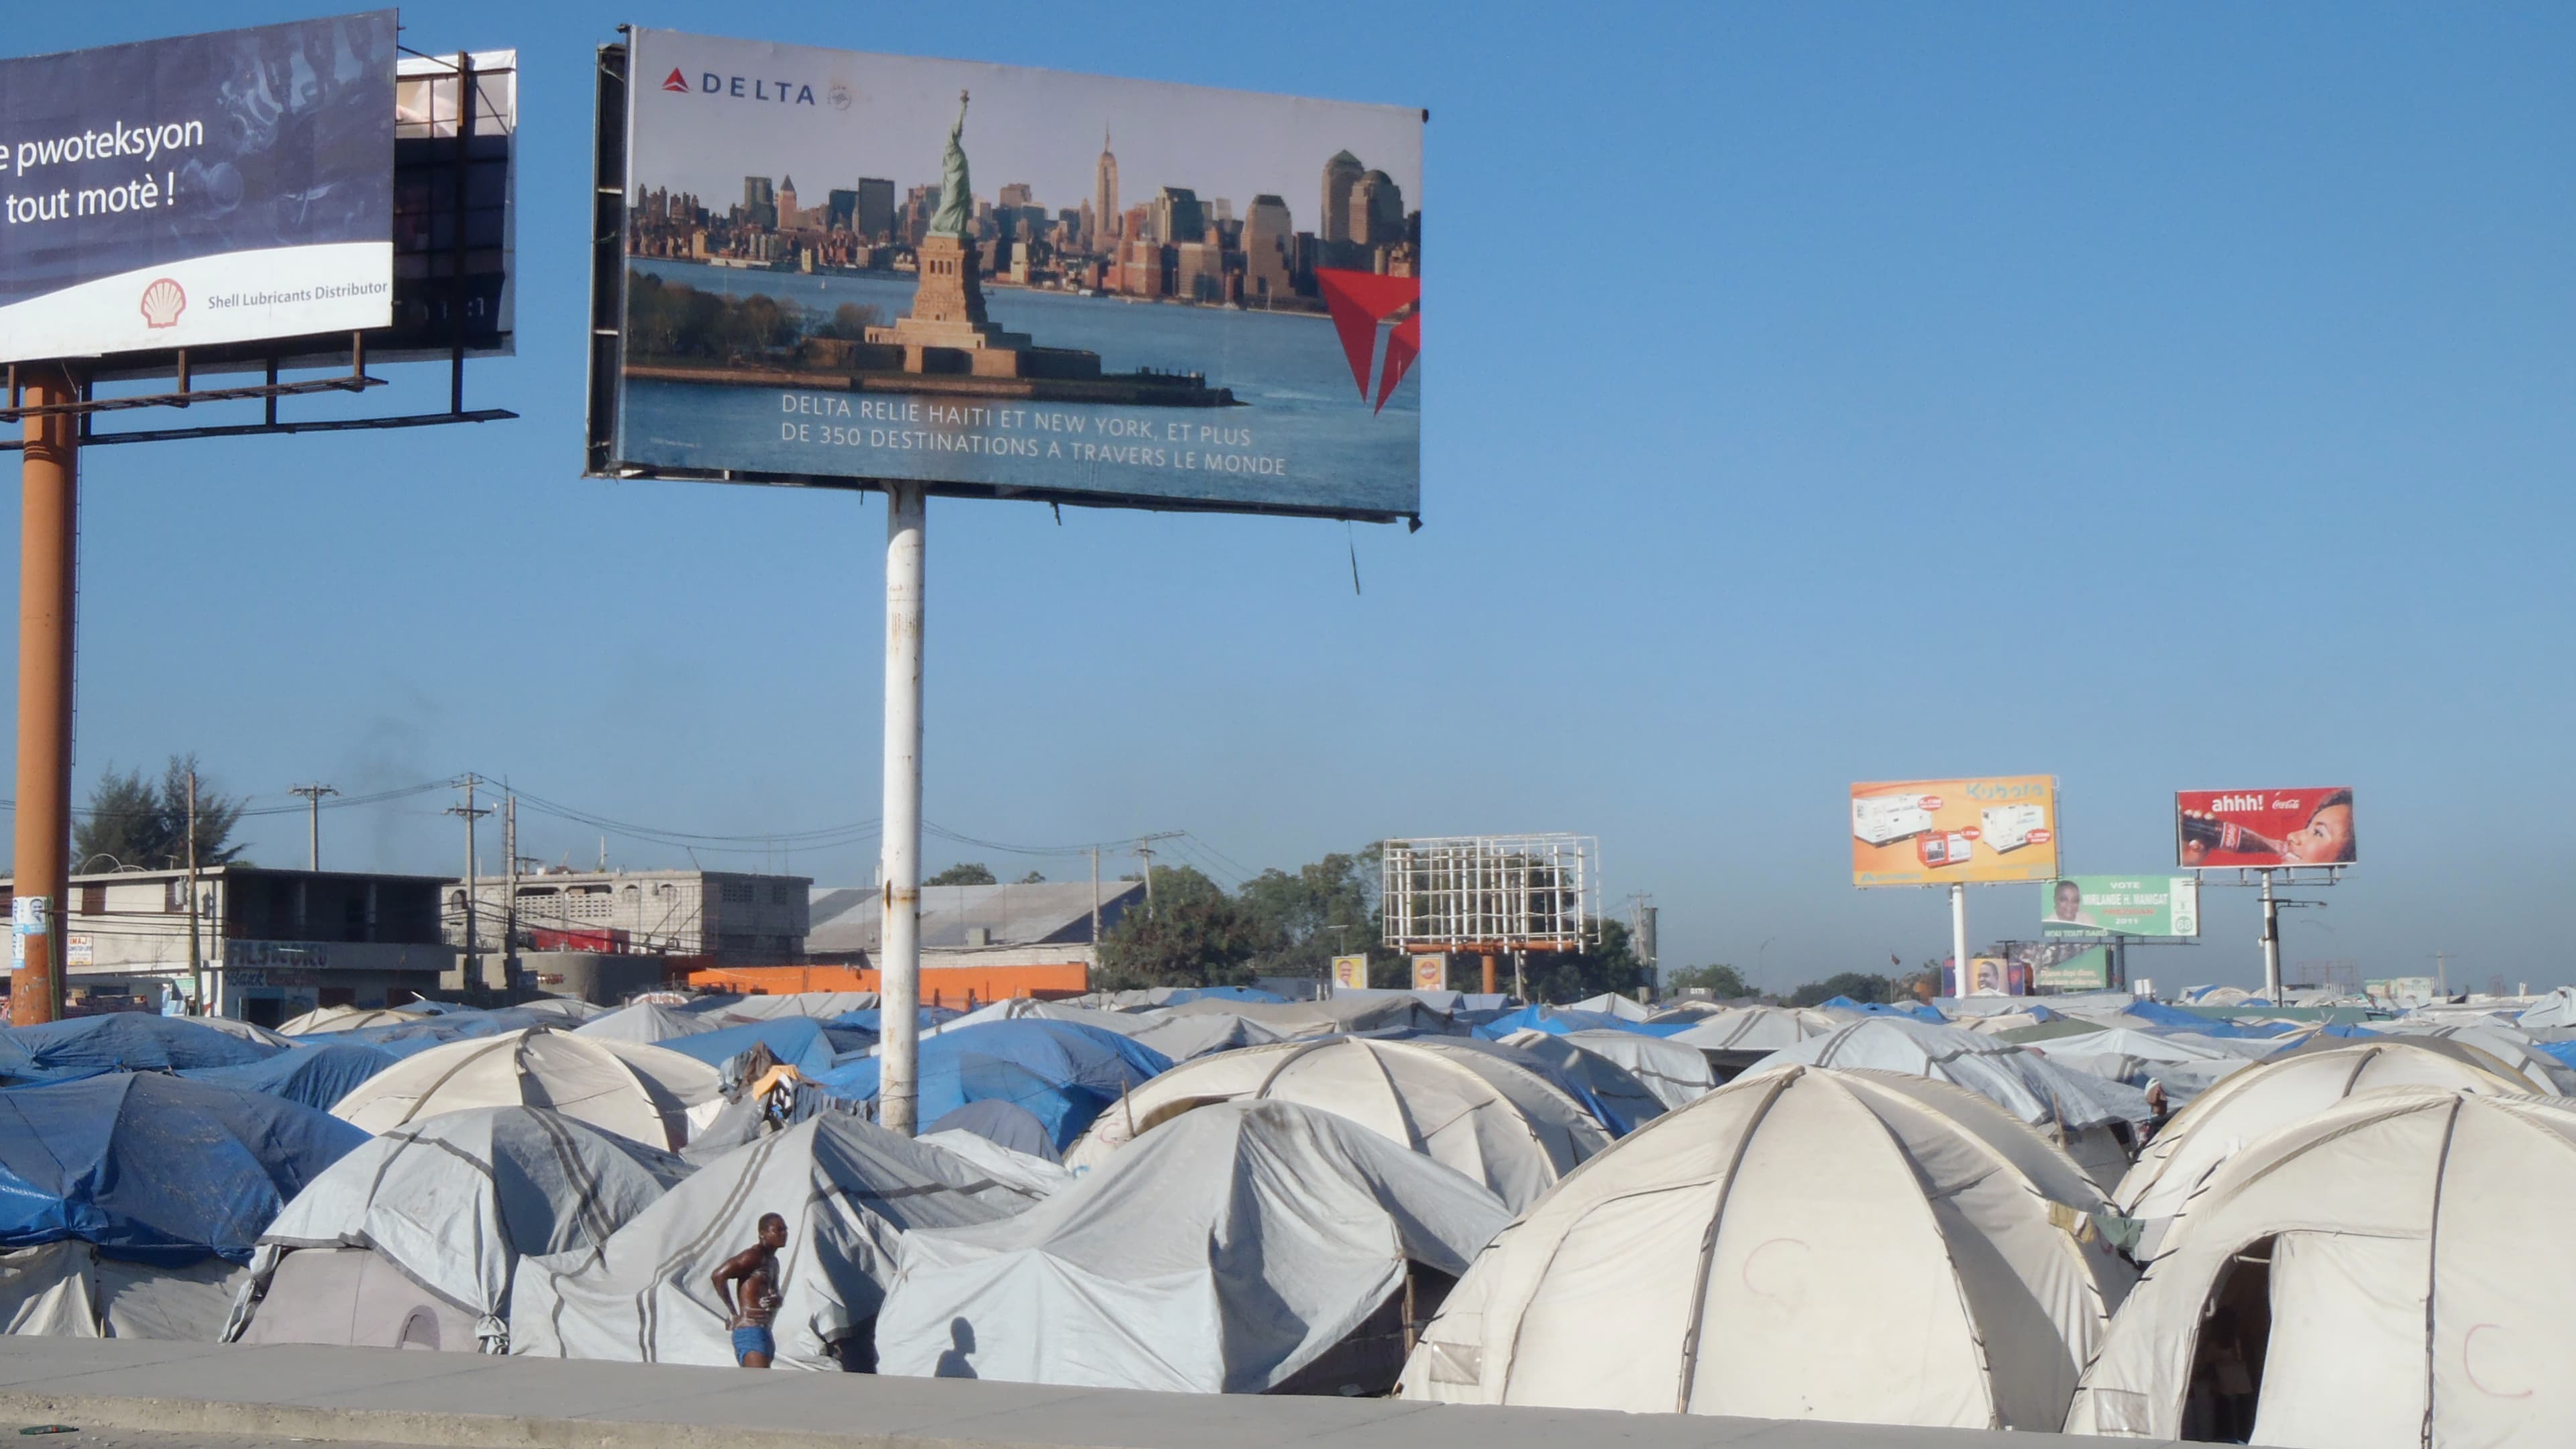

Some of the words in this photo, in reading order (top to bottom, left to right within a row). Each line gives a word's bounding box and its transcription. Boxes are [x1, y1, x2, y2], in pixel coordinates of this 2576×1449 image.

[702, 72, 816, 106] DELTA
[17, 121, 204, 177] pwoteksyon
[6, 189, 70, 224] tout
[78, 173, 158, 215] motè
[208, 295, 239, 310] Shell
[242, 288, 312, 307] Lubricants
[315, 281, 388, 299] Distributor
[782, 394, 851, 418] DELTA
[861, 401, 920, 423] RELIE
[929, 405, 991, 427] HAITI
[1001, 410, 1026, 429] ET
[1034, 413, 1086, 433] NEW
[1095, 418, 1159, 442] YORK,
[1167, 423, 1191, 442] ET
[1200, 425, 1251, 447] PLUS
[782, 423, 811, 443] DE
[819, 426, 861, 447] 350
[871, 429, 1038, 458] DESTINATIONS
[1046, 441, 1061, 459] A
[1070, 443, 1166, 468] TRAVERS
[1174, 451, 1195, 470] LE
[1204, 455, 1287, 476] MONDE
[2212, 794, 2264, 812] ahhh!
[2082, 894, 2122, 906] MIRLANDE
[2178, 920, 2191, 930] 68
